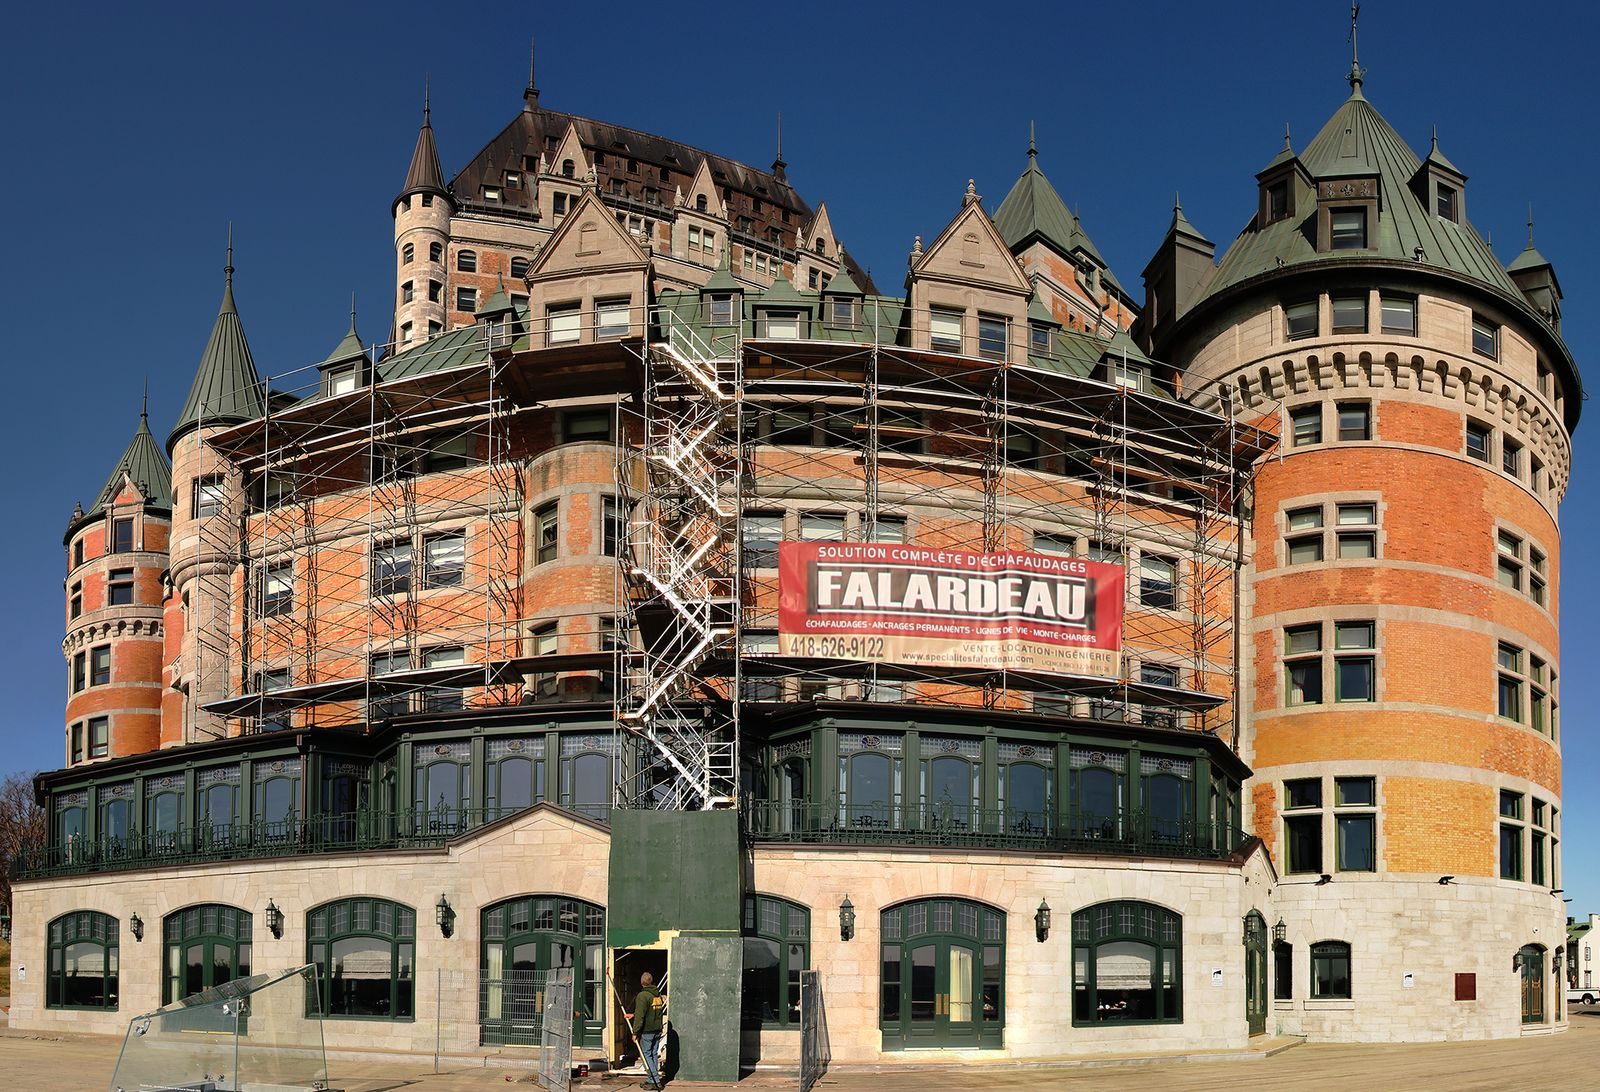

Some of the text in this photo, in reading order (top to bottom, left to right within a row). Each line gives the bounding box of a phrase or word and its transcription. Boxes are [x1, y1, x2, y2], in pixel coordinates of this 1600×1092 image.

[818, 546, 1087, 573] SOLUTION COMPLÈTE D'ÉCHAFAUDAGES
[817, 570, 1087, 620] FALARDEAU
[805, 619, 1097, 643] ÉCHAFAUDAGES ANCRAGES PERMANENTS LIGNES DE VIE MONTE-CHARGES
[790, 636, 885, 659] 418-626-9122
